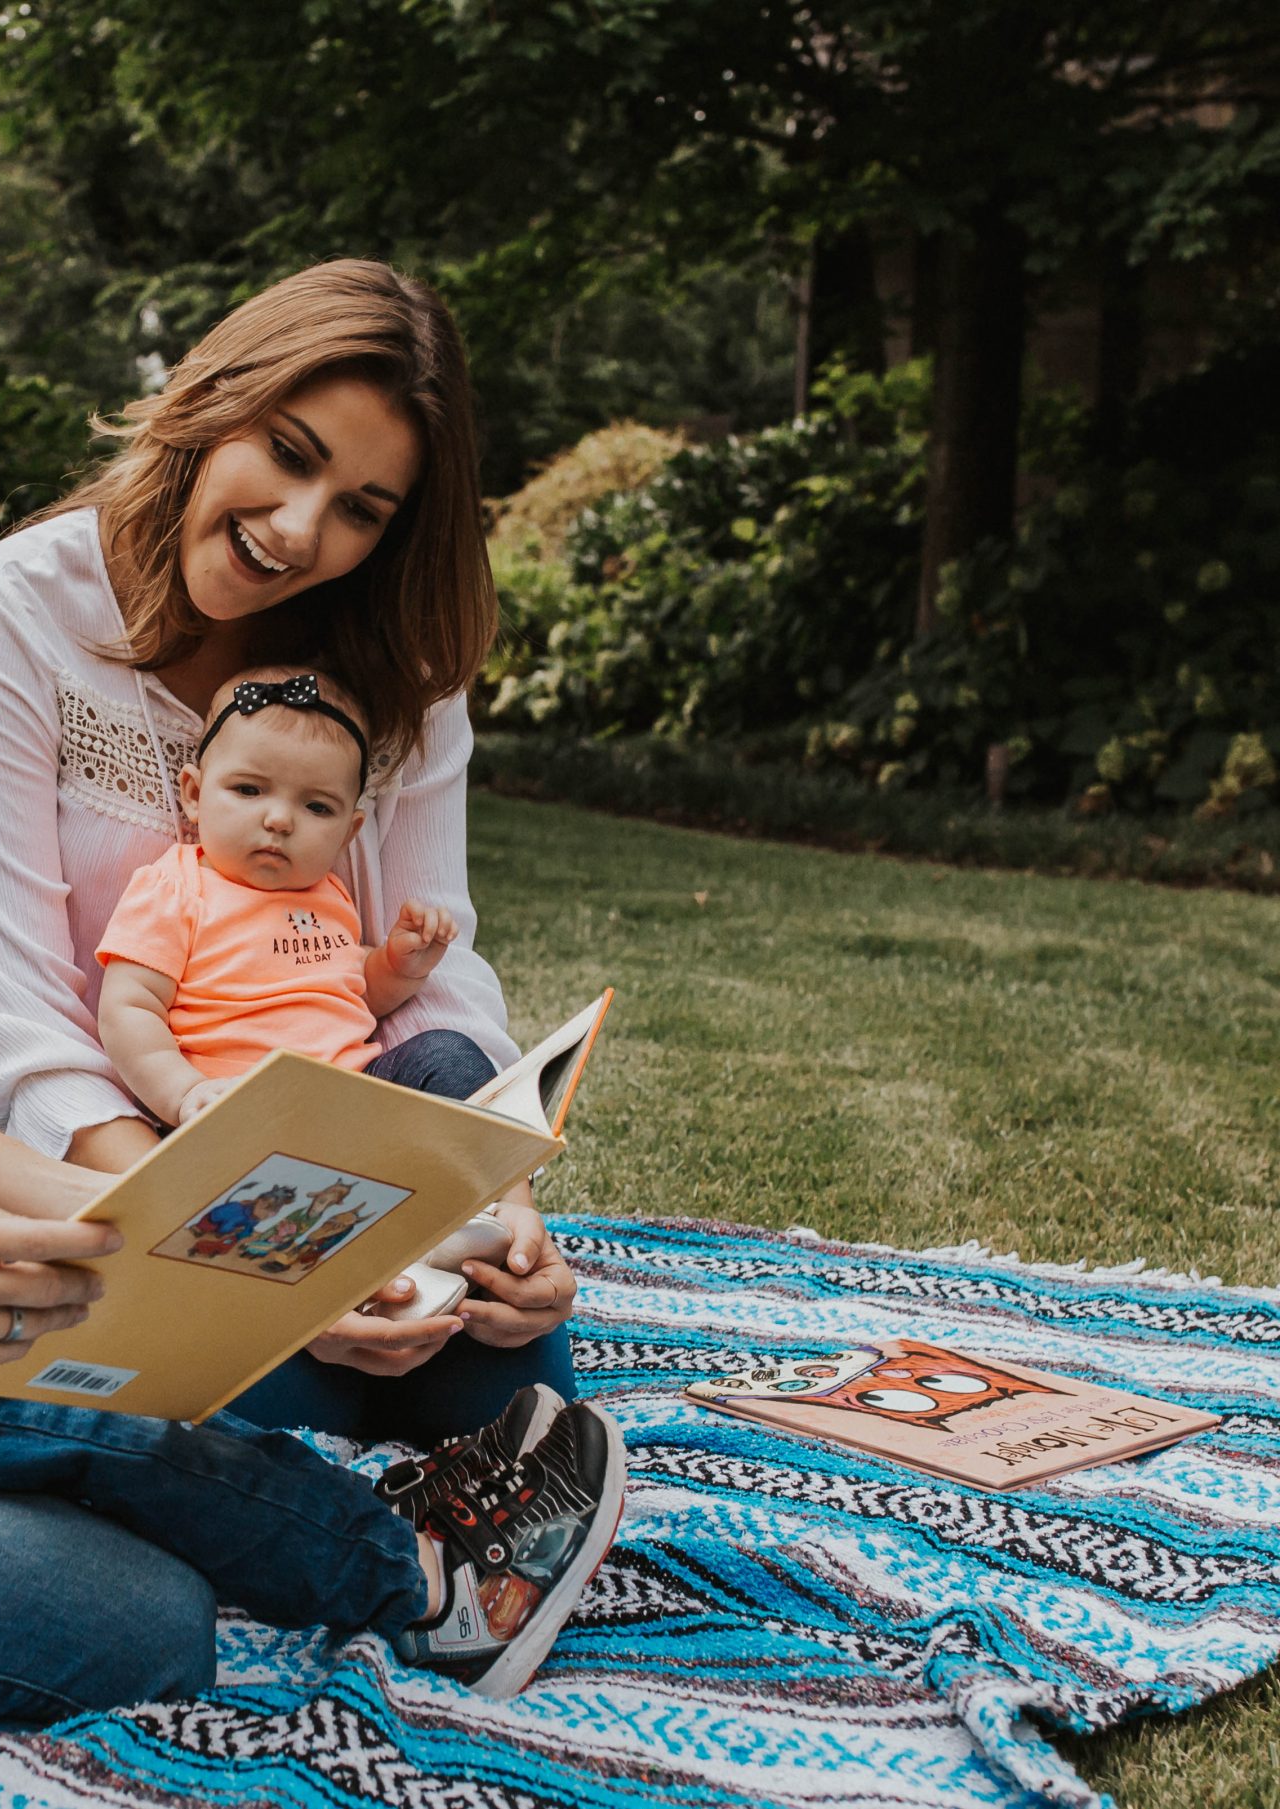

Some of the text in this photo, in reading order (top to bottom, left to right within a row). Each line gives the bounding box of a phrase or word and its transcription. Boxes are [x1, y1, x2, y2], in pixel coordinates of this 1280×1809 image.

[273, 934, 349, 954] ADORABLE
[295, 952, 331, 966] ALL DAY
[1023, 1411, 1067, 1425] Last
[937, 1422, 1030, 1447] Chocolate
[980, 1426, 1111, 1466] Monster
